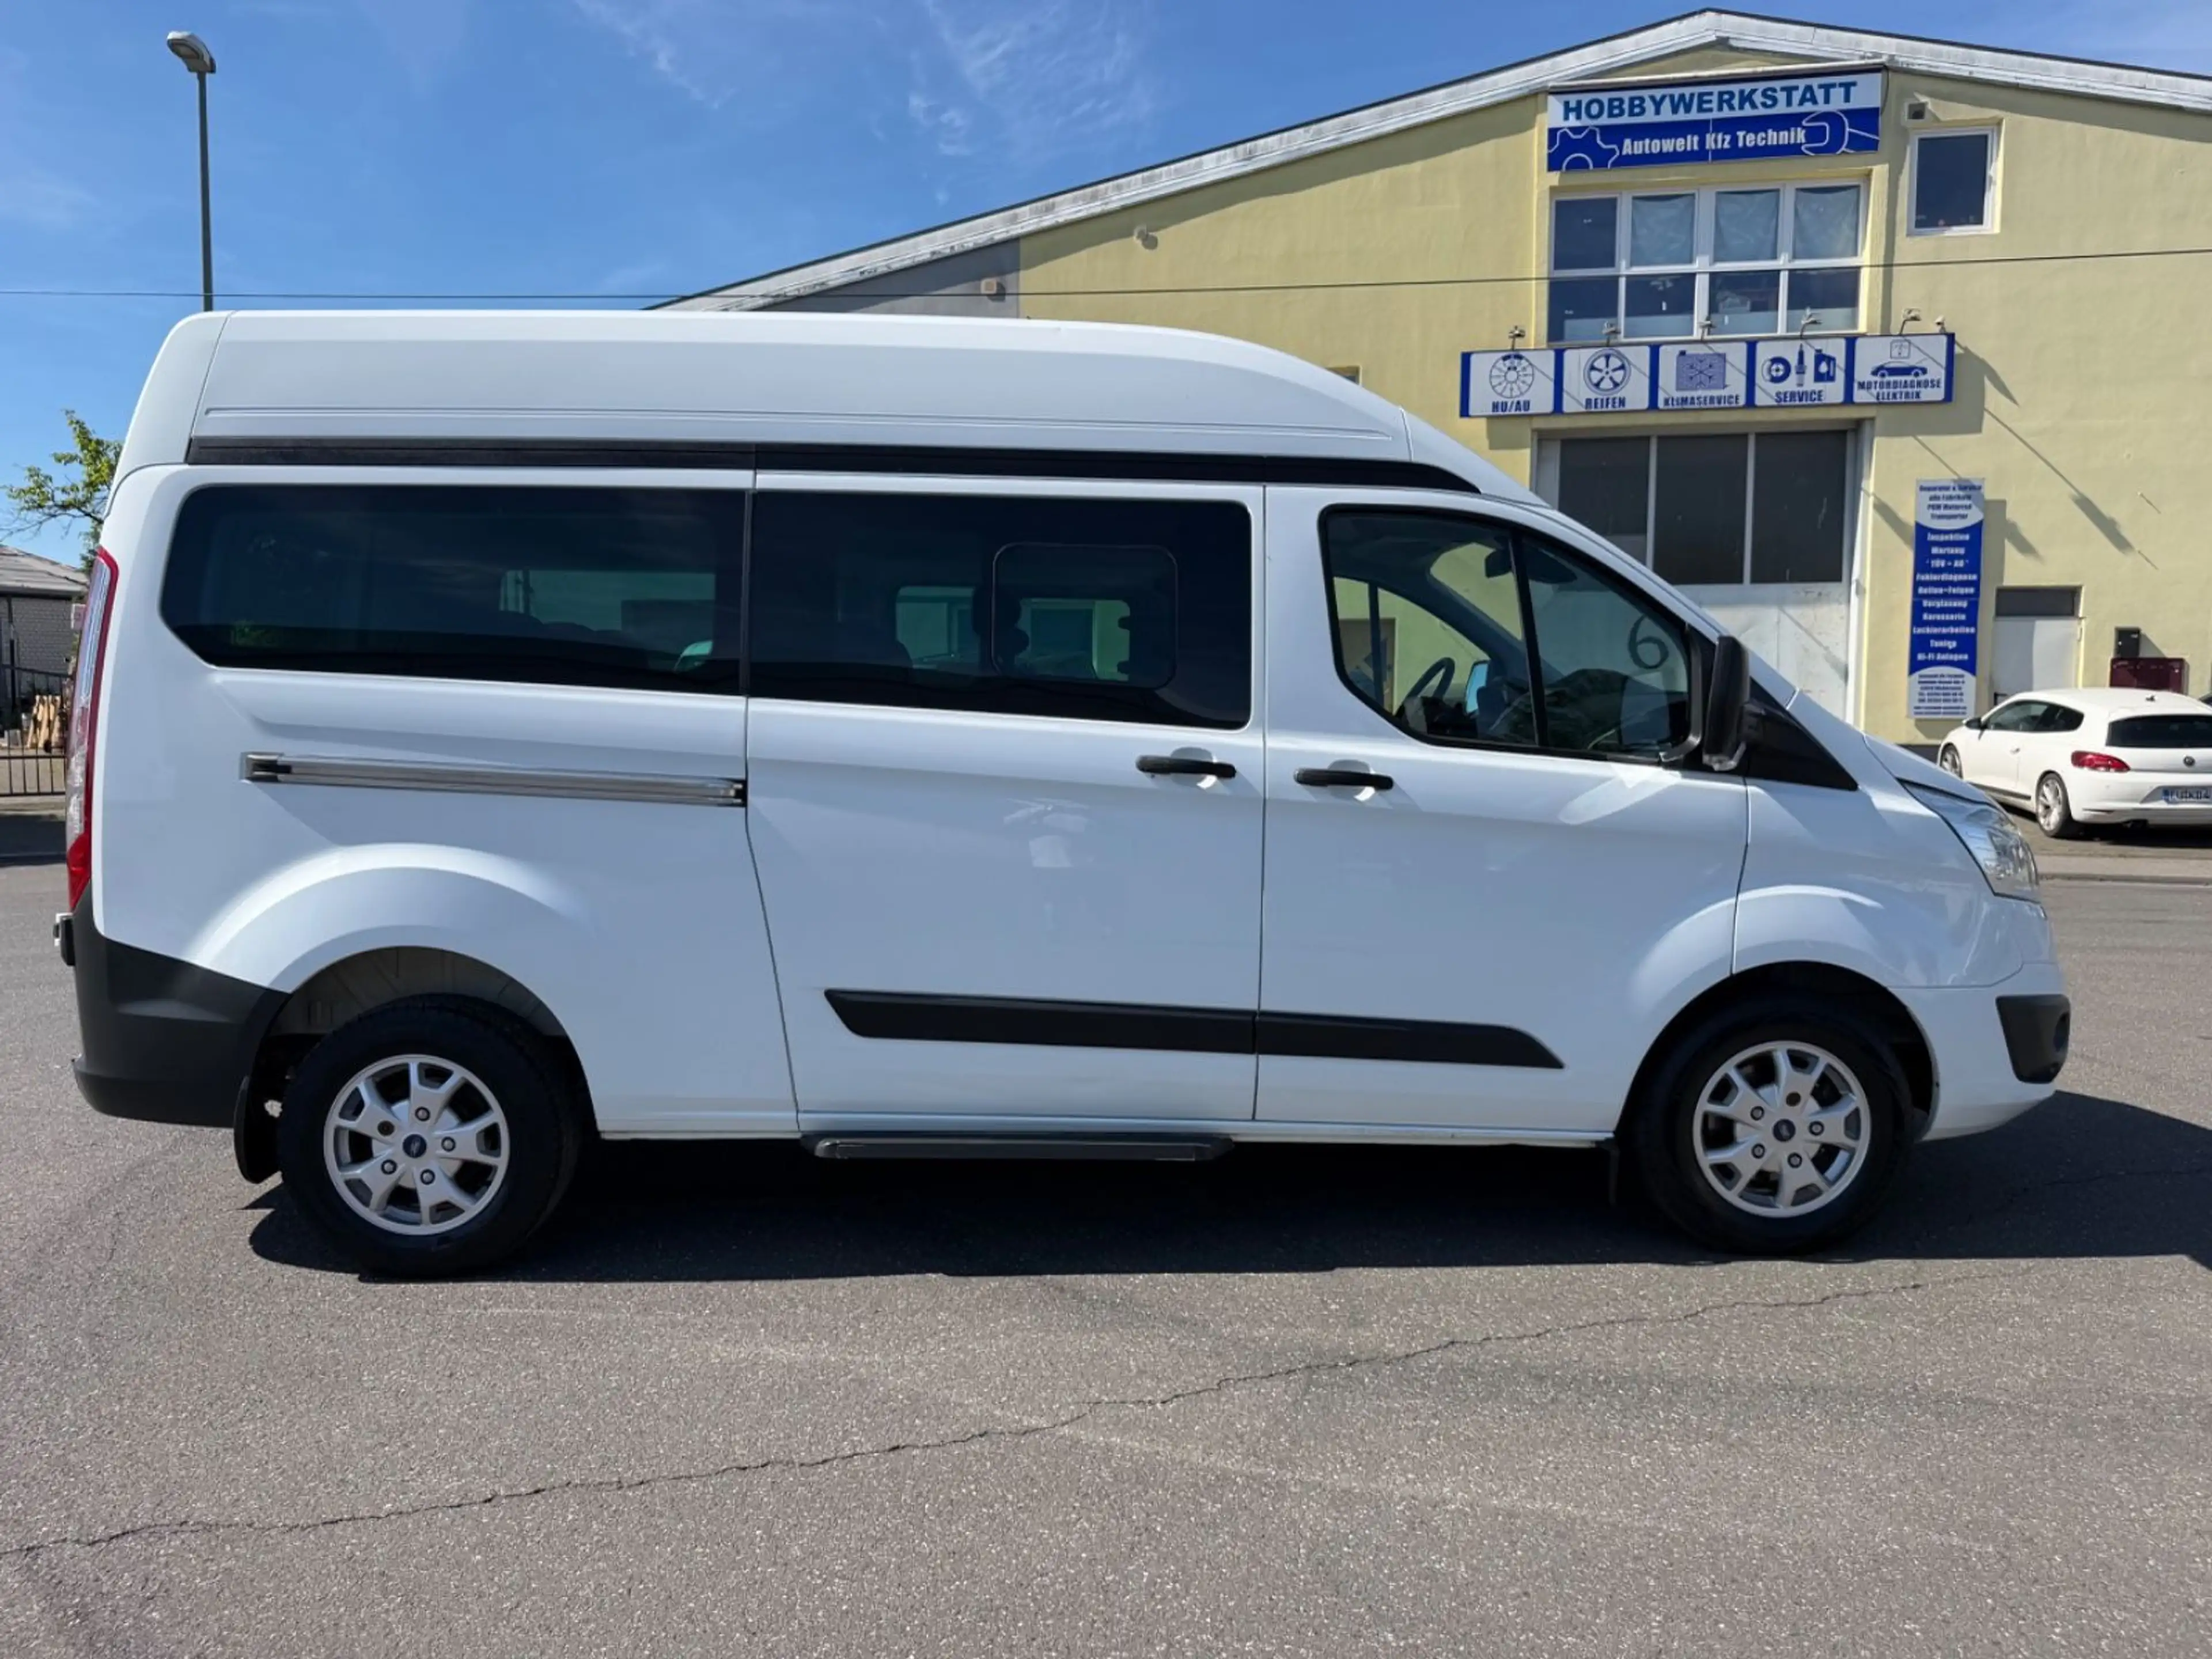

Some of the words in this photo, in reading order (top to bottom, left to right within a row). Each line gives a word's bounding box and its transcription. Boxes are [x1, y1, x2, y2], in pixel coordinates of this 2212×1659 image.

[1562, 81, 1858, 121] HOBBYWERKSTATT
[1621, 132, 1699, 156] Autowelt
[1705, 131, 1731, 150] Kfz
[1736, 127, 1806, 147] Technik
[1857, 378, 1941, 391] MOTORDIAGNOSE
[1585, 396, 1626, 410] REIFEN
[1663, 393, 1740, 407] KLIMASERVICE
[1774, 389, 1824, 404] SERVICE
[1876, 391, 1922, 401] ELEKTRIK
[1491, 400, 1531, 413] HU/AU
[1628, 615, 1669, 669] 6
